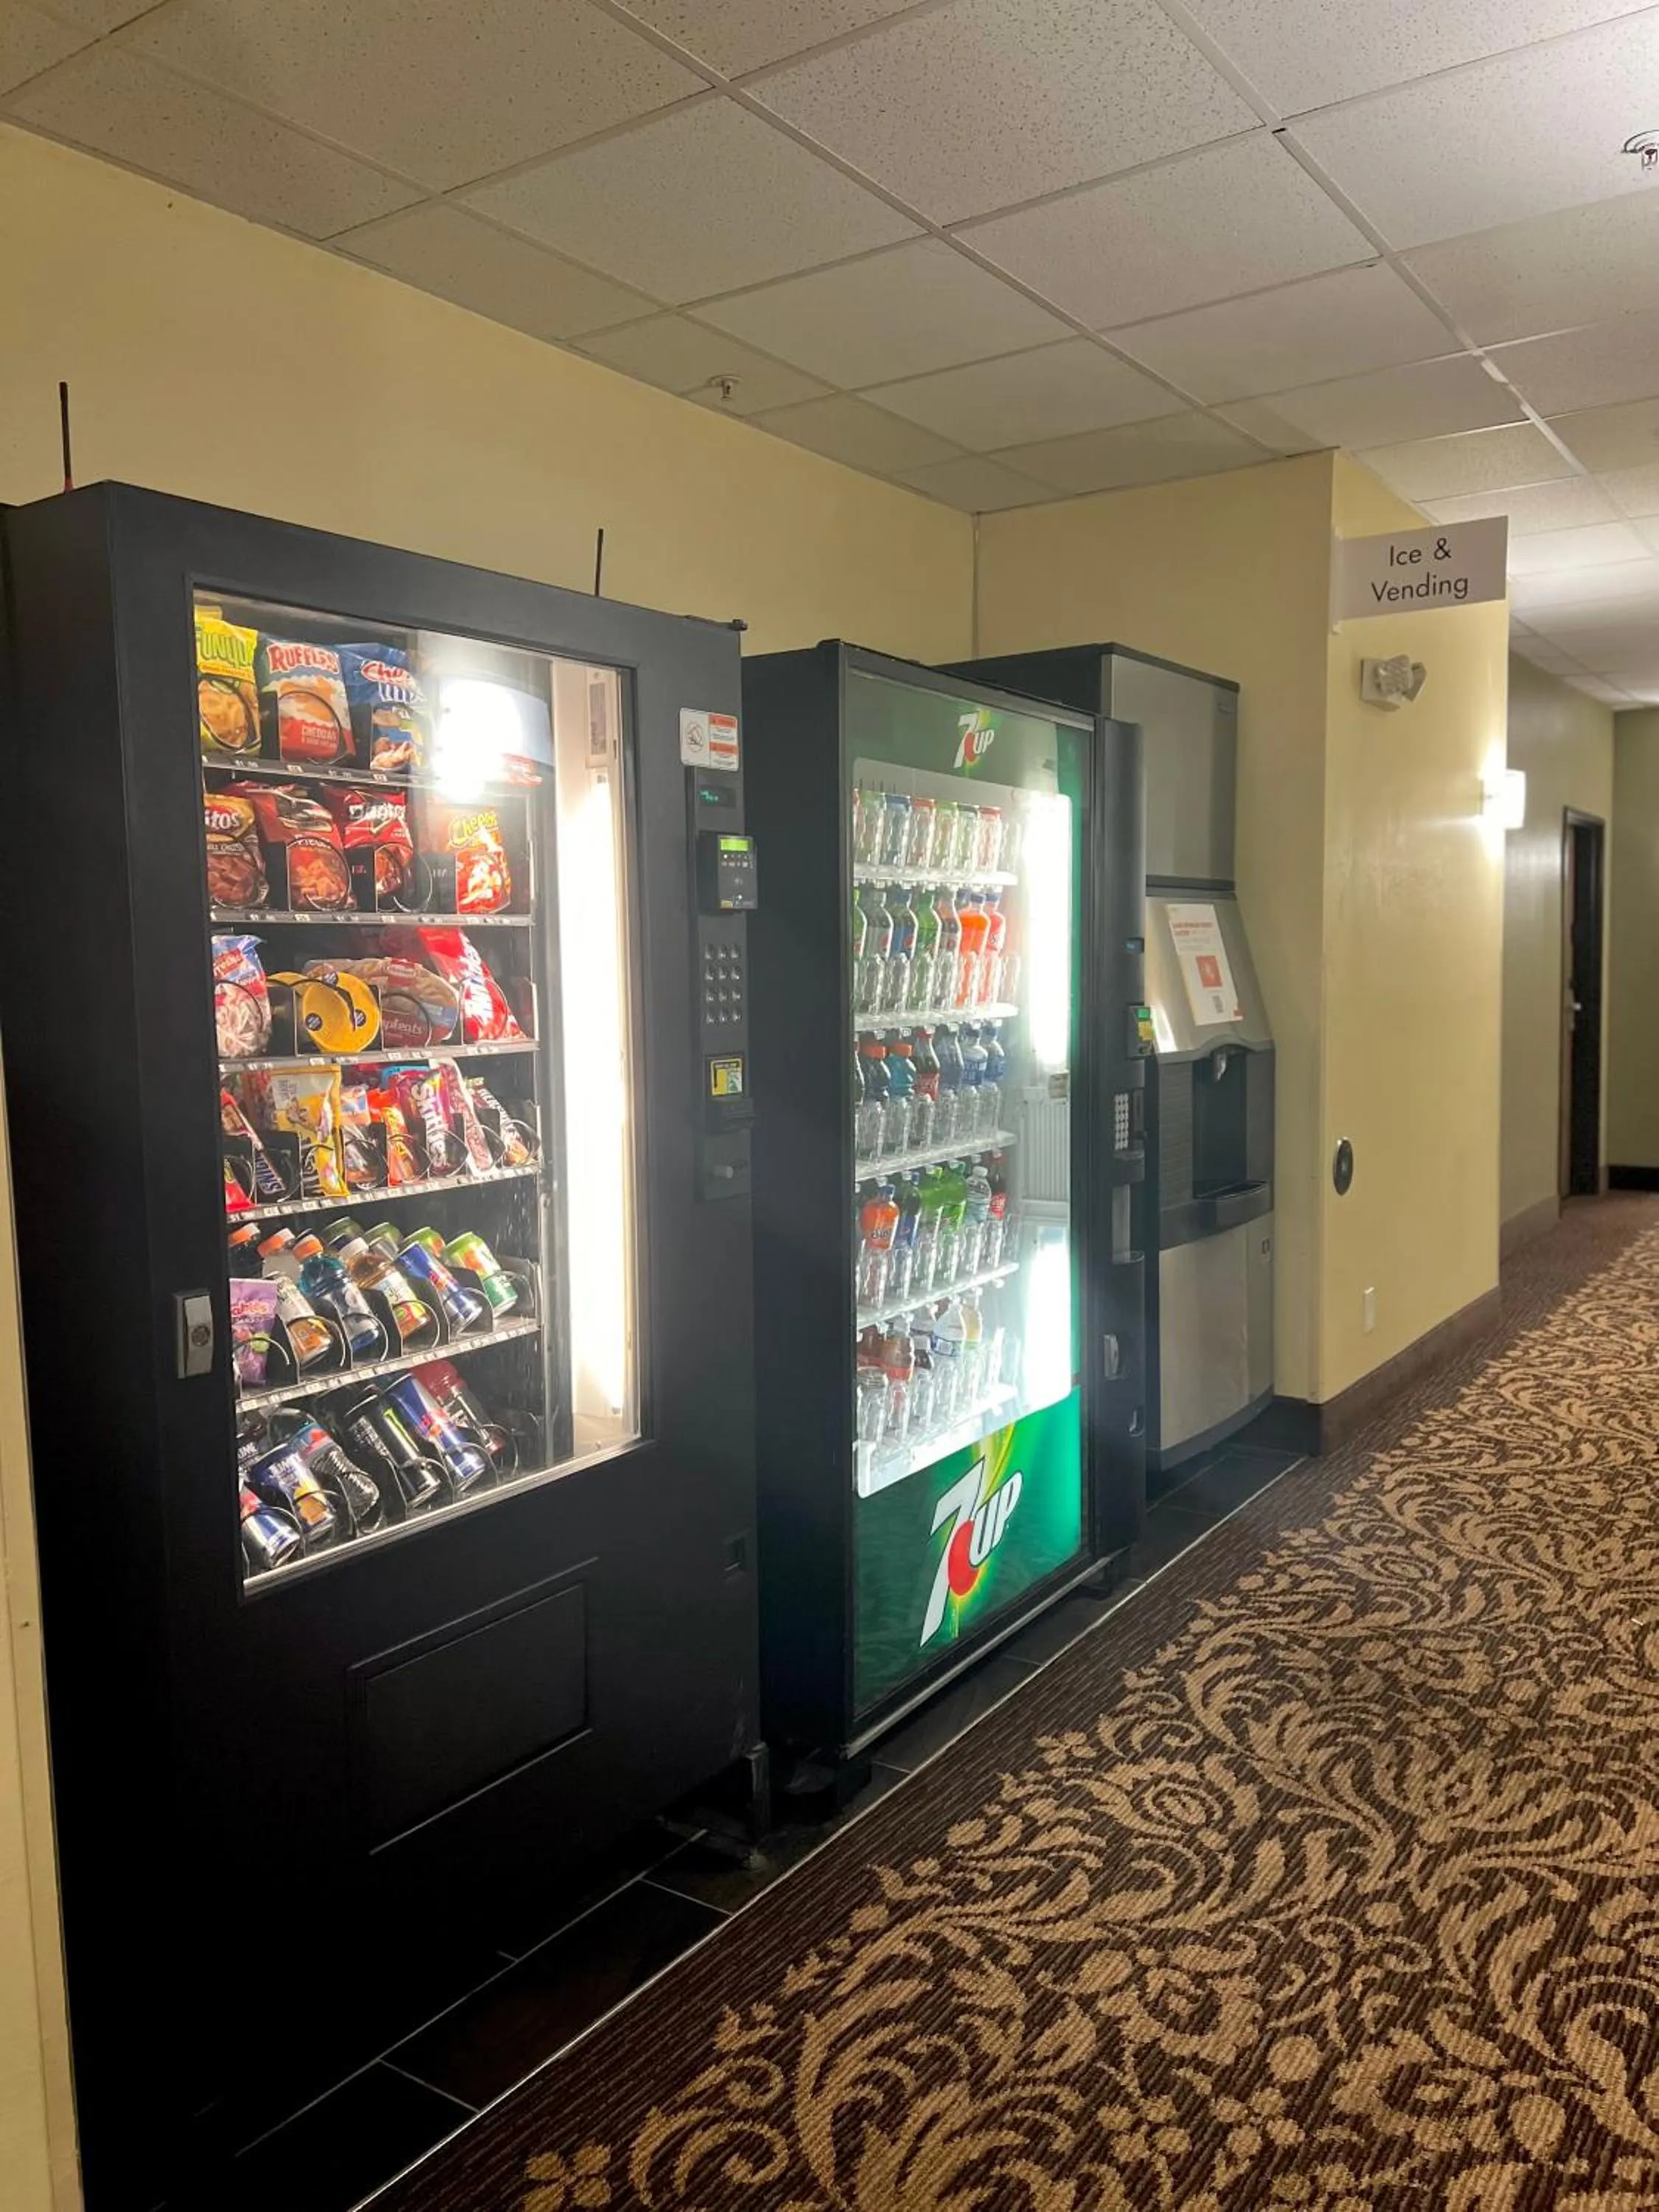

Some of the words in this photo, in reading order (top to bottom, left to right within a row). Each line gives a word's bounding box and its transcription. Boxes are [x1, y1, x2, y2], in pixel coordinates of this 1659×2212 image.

[1389, 545, 1422, 567] Ice
[1433, 538, 1452, 560] &
[1370, 571, 1469, 602] Vending
[268, 643, 340, 673] RUFFLES
[953, 712, 995, 769] 7UP
[205, 808, 240, 830] itos
[919, 1455, 1023, 1648] 7UP
